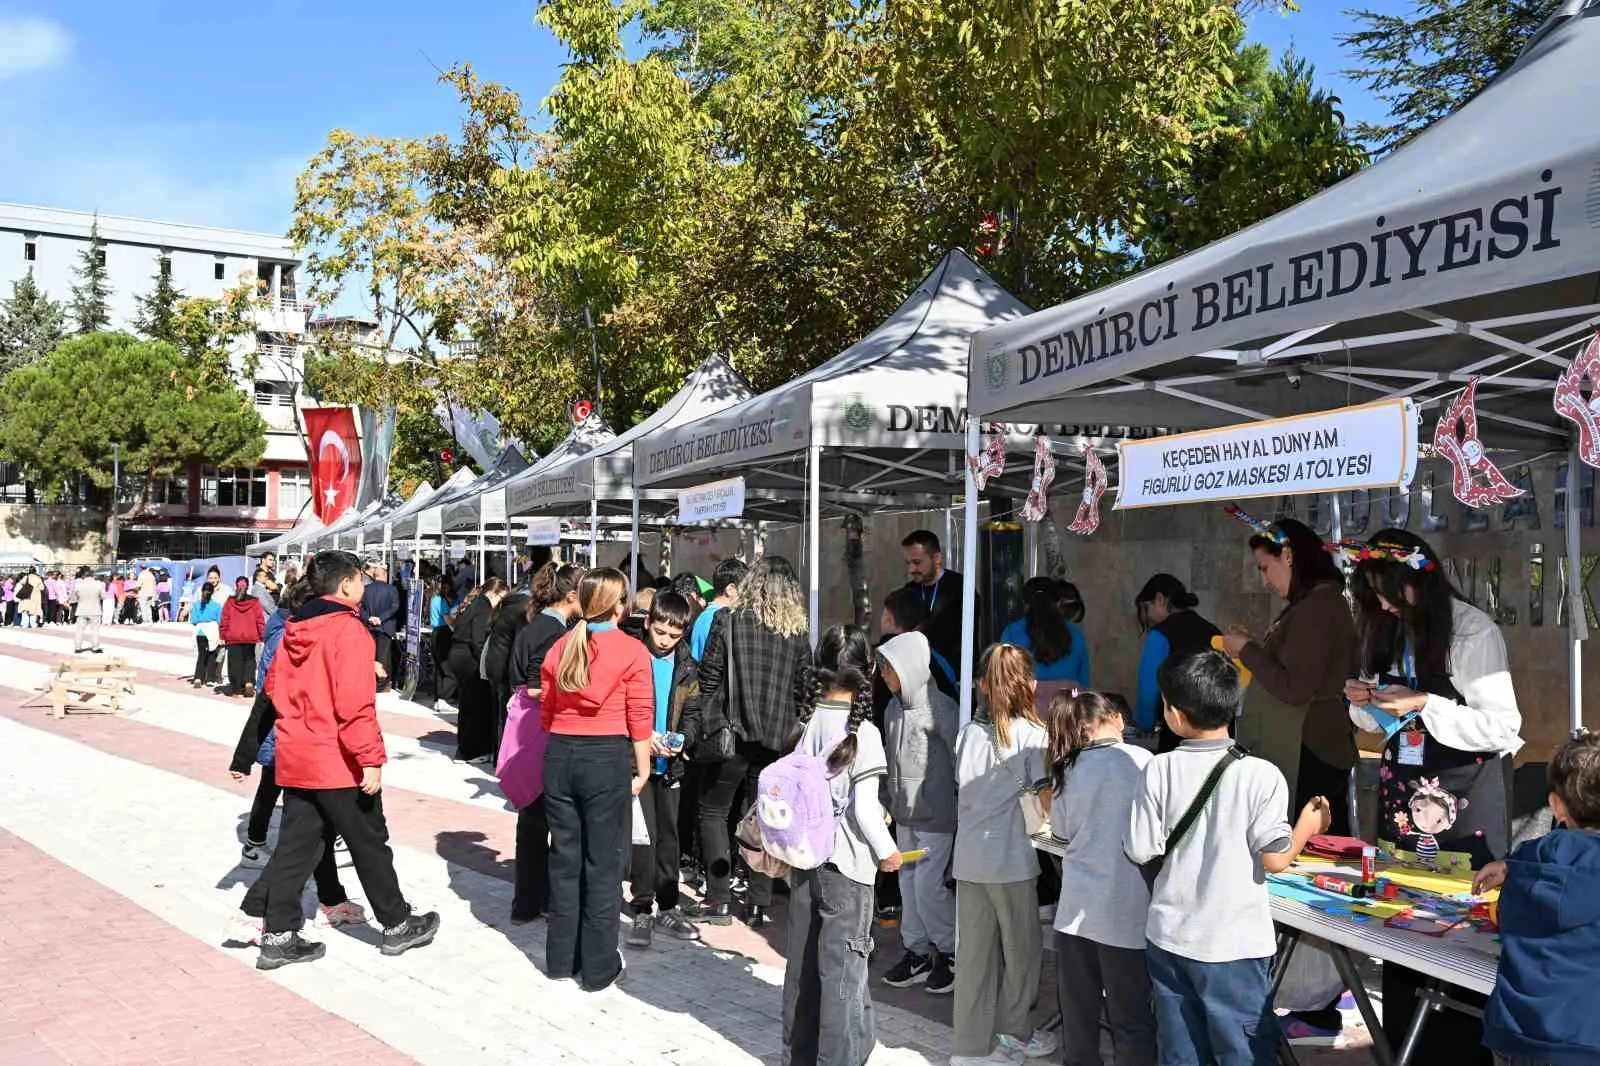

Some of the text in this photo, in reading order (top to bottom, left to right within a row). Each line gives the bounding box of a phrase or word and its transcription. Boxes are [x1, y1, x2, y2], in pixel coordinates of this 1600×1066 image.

[1016, 168, 1563, 386] DEMİRCİ BELEDİYESİ
[649, 409, 776, 474] DEMİRCİ BELEDİYESİ
[1162, 445, 1221, 472] KEÇEDEN
[1223, 438, 1269, 461] HAYAL
